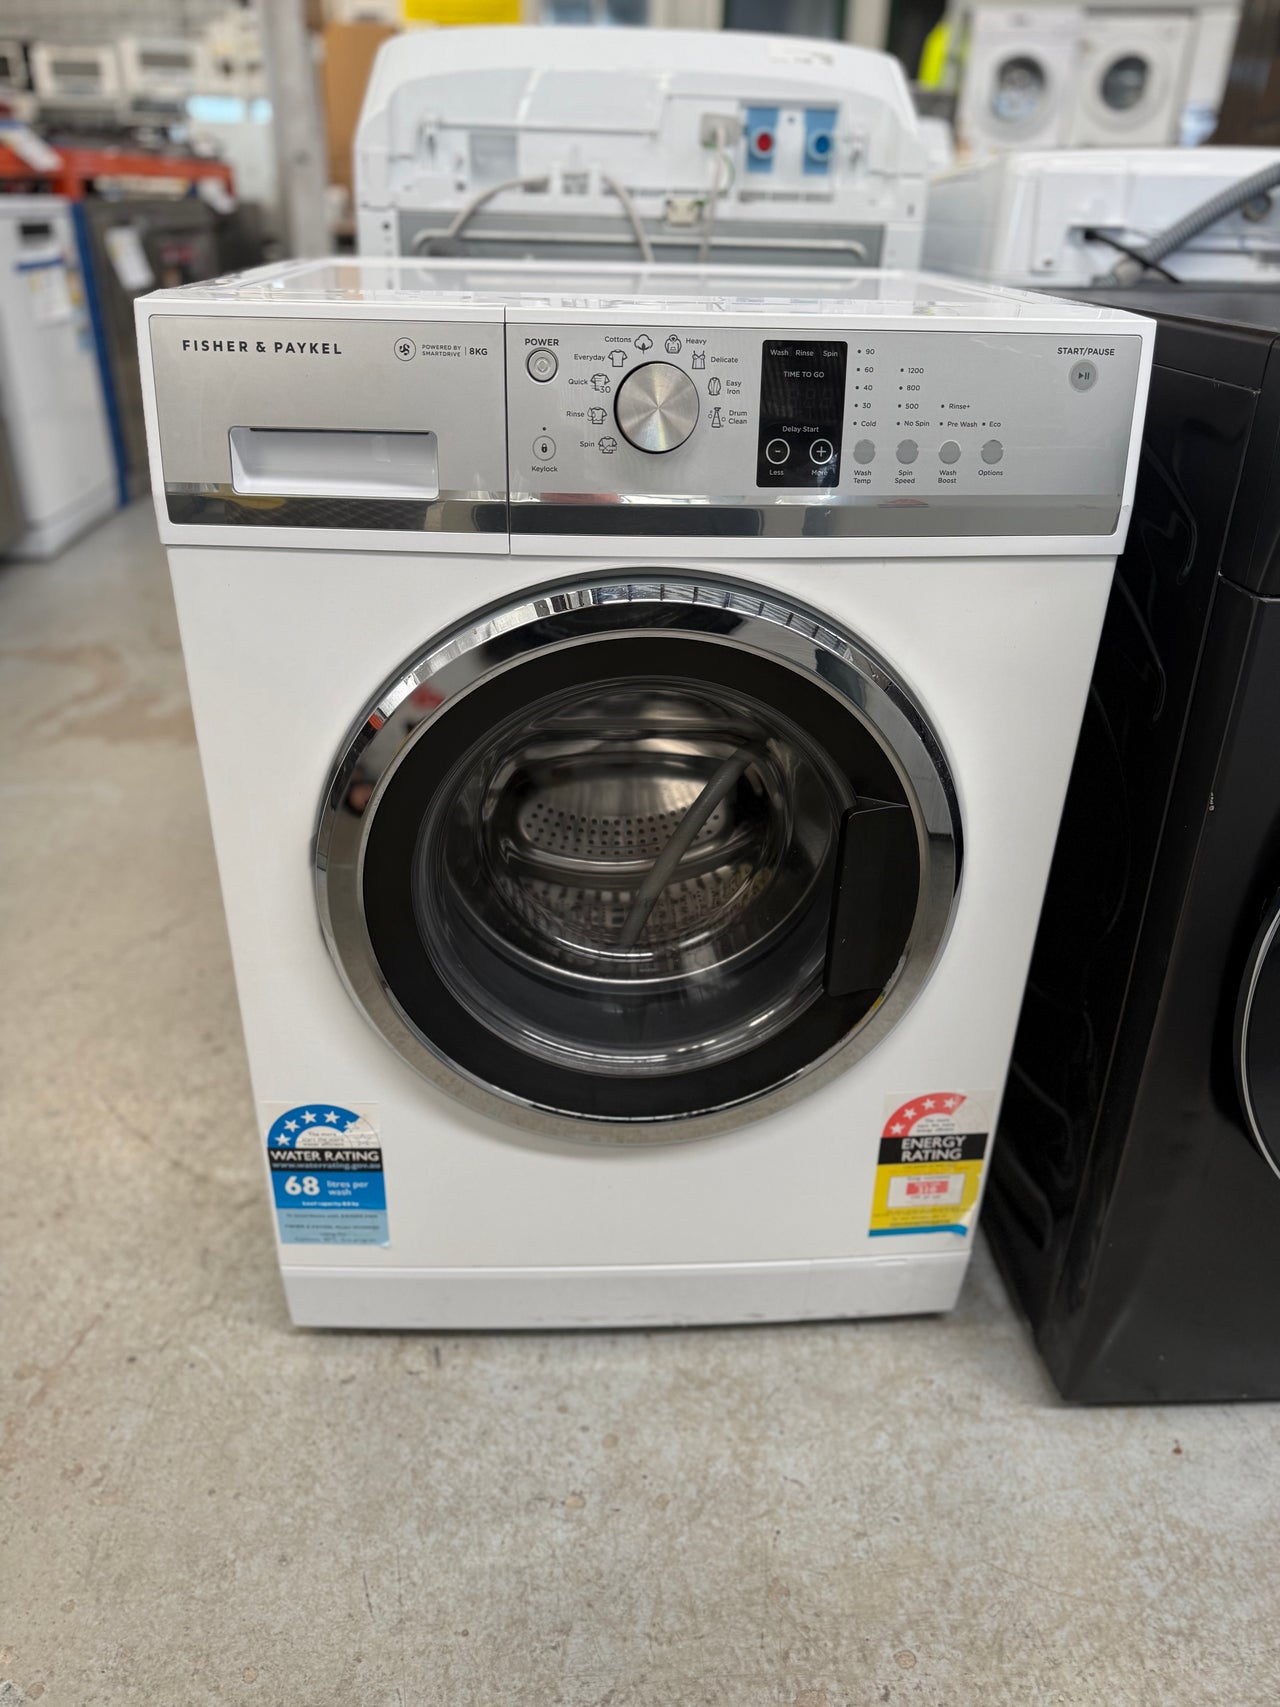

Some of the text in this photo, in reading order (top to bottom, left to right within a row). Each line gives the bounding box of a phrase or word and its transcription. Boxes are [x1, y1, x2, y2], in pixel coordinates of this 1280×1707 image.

[524, 338, 560, 346] POWER
[604, 336, 632, 344] Cottons
[686, 338, 707, 346] Heavy
[182, 340, 342, 354] FISHER & PAYKEL
[469, 347, 488, 356] 8KG
[822, 350, 838, 358] Spin
[1057, 347, 1116, 356] START/PAUSE
[574, 354, 606, 362] Everyday
[710, 356, 738, 364] Delicate
[568, 378, 588, 386] Quick
[726, 380, 742, 388] Easy
[600, 386, 611, 394] 30
[566, 410, 585, 418] Rinse
[728, 417, 748, 425] Clean
[915, 420, 930, 428] Spin
[579, 440, 595, 448] Spin
[531, 465, 558, 473] Keylock
[901, 1136, 967, 1150] ENERGY
[270, 1150, 380, 1162] WATER RATING
[901, 1150, 962, 1162] RATING
[284, 1175, 320, 1196] 68
[326, 1180, 350, 1188] litres
